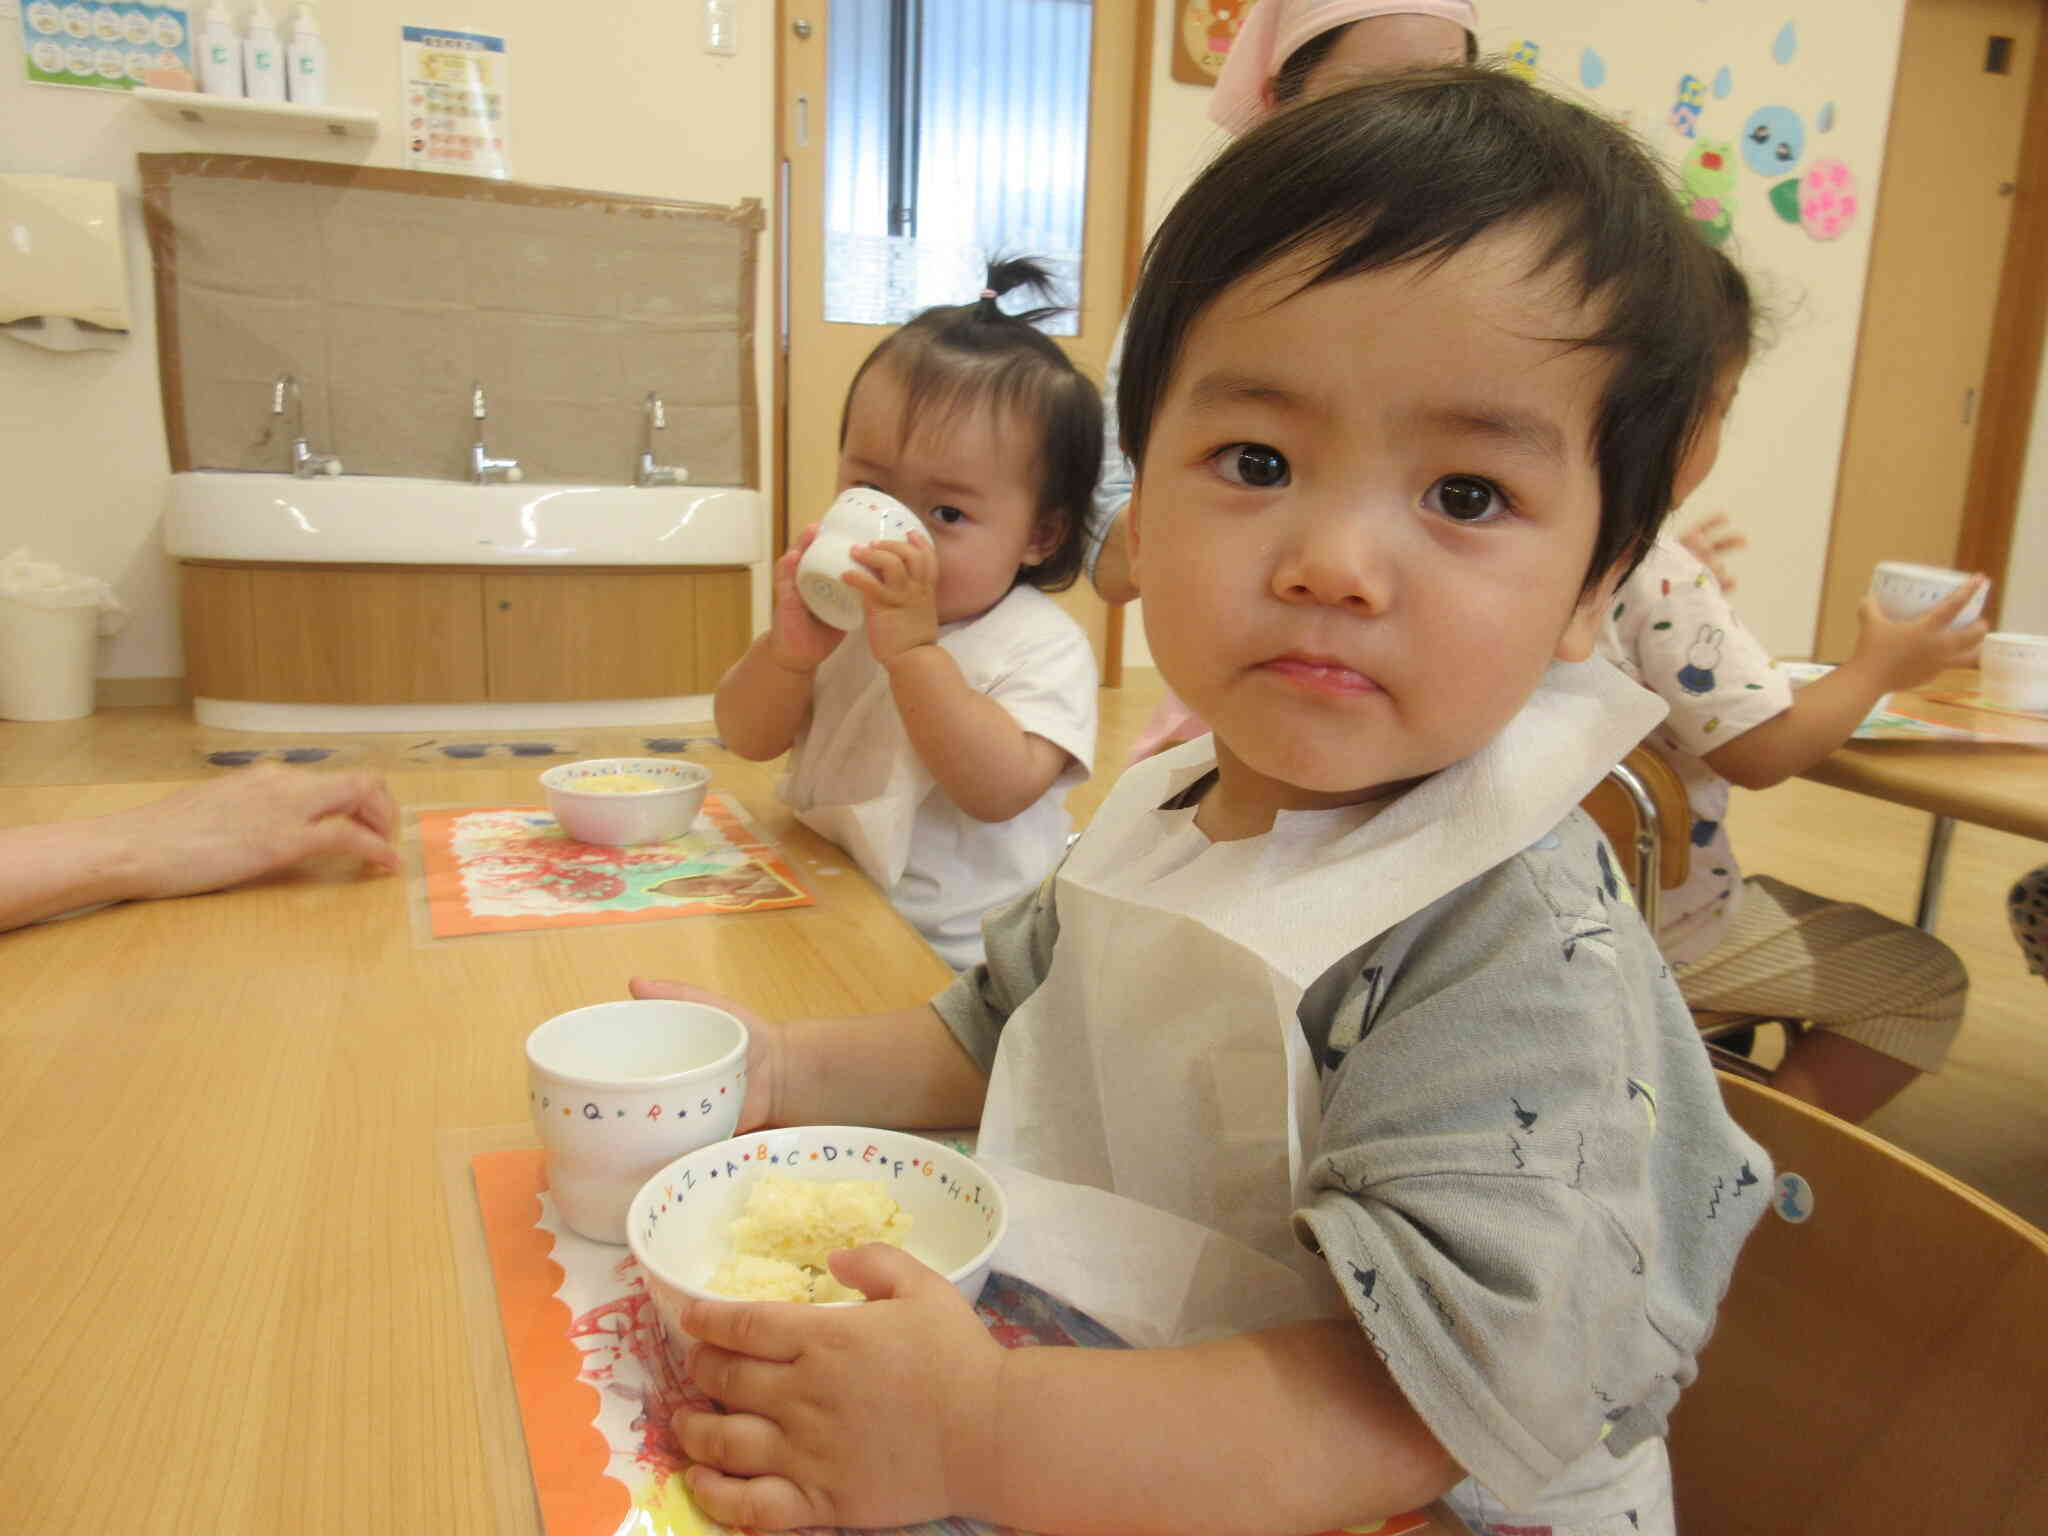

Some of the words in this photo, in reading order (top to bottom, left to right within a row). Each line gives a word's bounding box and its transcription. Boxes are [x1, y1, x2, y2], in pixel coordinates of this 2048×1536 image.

[583, 1103, 603, 1120] Q
[647, 1104, 662, 1120] R
[700, 1098, 712, 1115] S
[682, 1169, 696, 1190] Z
[726, 1160, 738, 1177] A
[756, 1144, 768, 1160] B
[786, 1150, 800, 1166] C
[823, 1146, 837, 1161] D
[862, 1145, 878, 1163] E
[894, 1161, 904, 1178] F
[922, 1161, 933, 1176] G
[948, 1181, 960, 1199] H
[974, 1186, 981, 1204] I
